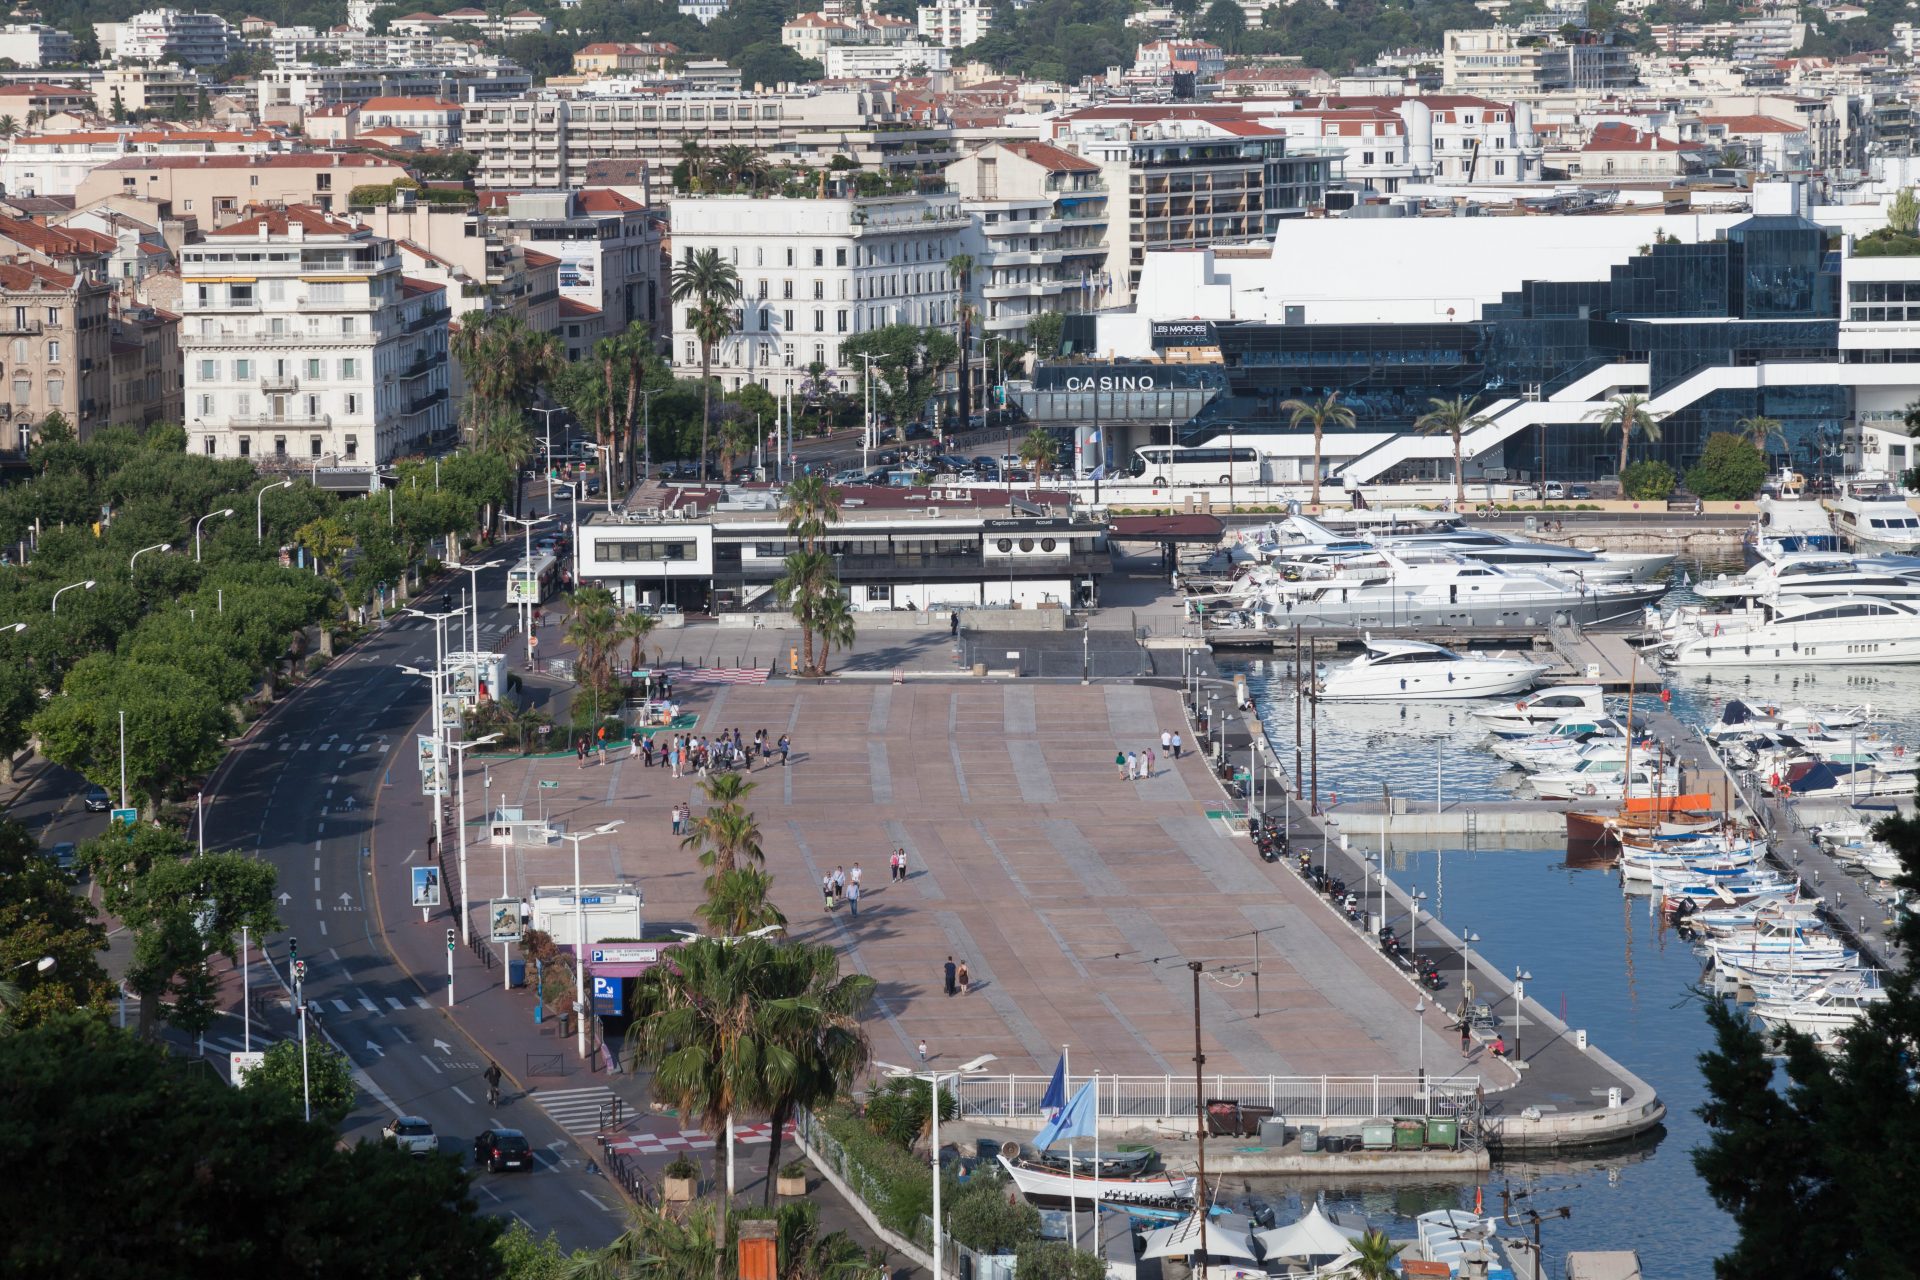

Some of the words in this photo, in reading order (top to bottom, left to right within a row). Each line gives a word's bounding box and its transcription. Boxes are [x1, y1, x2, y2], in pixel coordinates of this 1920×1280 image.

[1154, 325, 1168, 333] LES
[1169, 325, 1206, 333] MARCHES
[1066, 375, 1154, 391] CASINO
[593, 951, 603, 961] P
[594, 977, 607, 994] P
